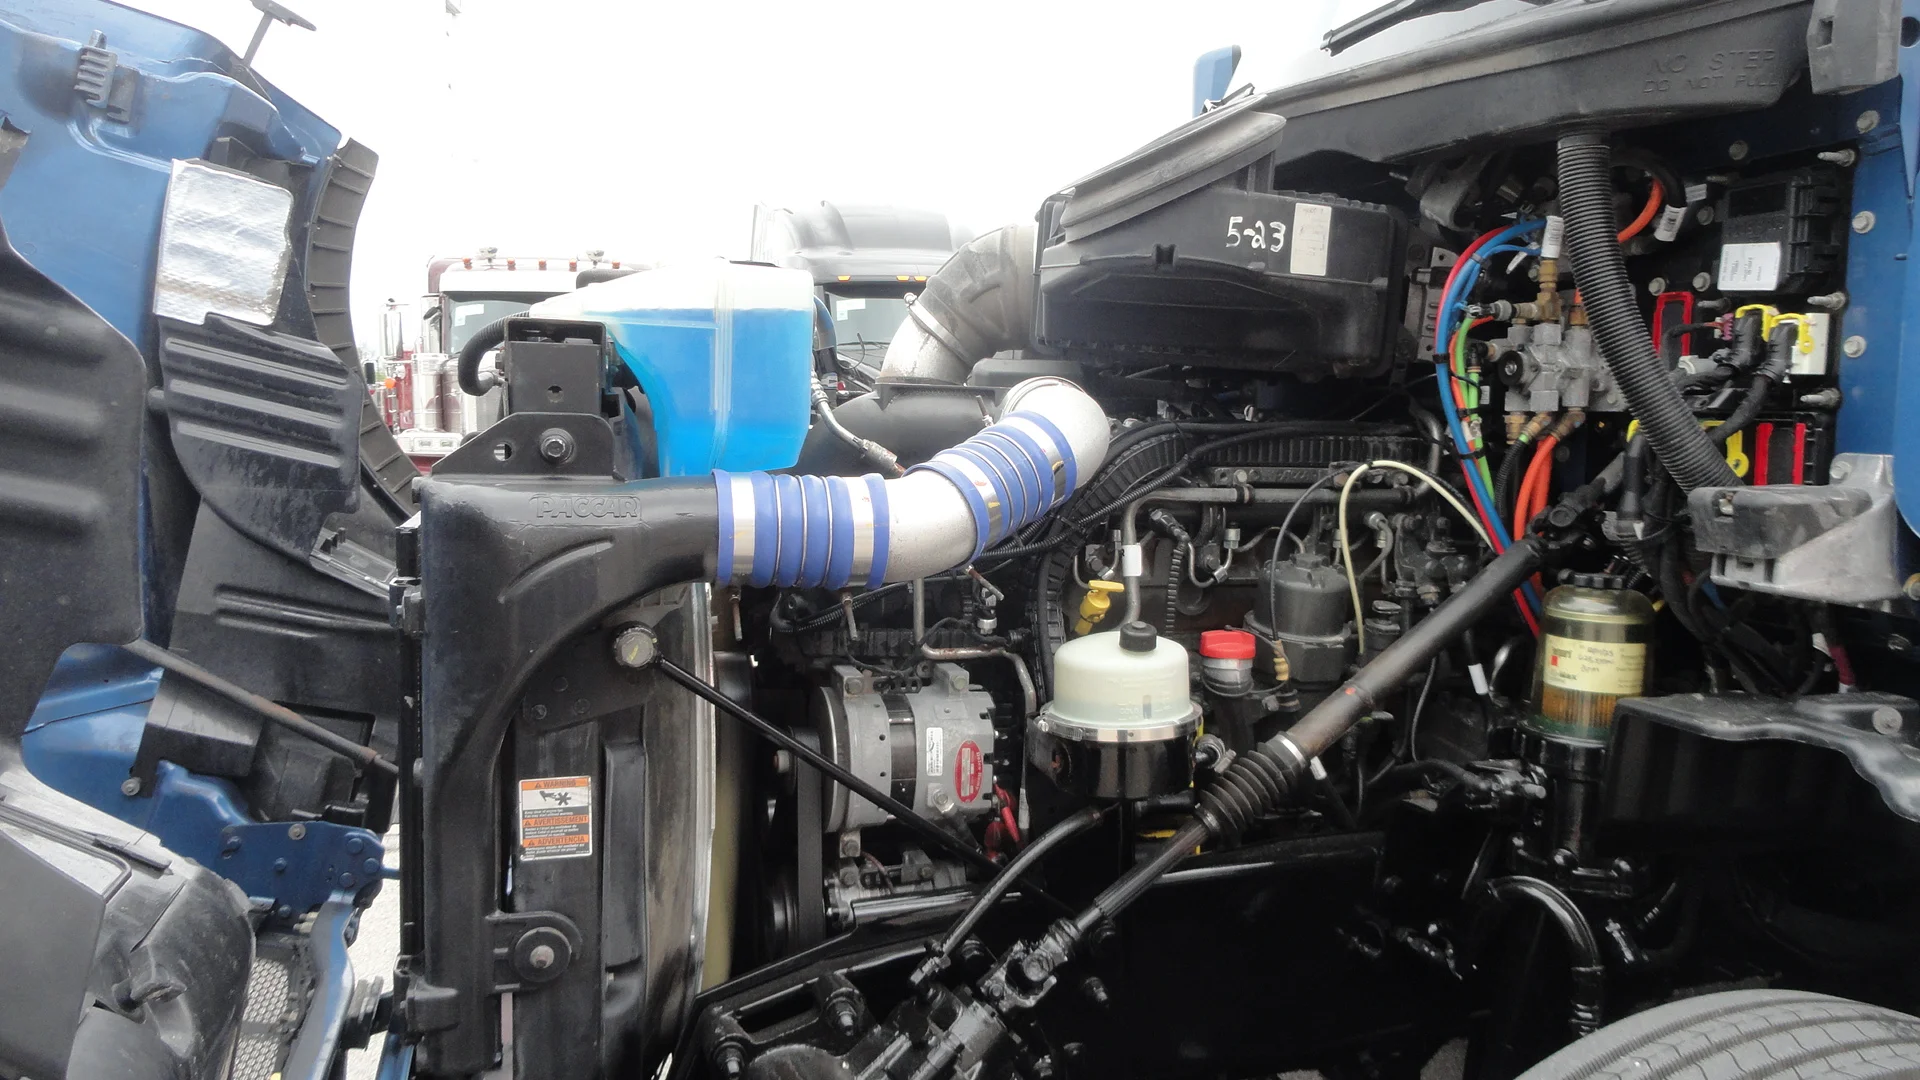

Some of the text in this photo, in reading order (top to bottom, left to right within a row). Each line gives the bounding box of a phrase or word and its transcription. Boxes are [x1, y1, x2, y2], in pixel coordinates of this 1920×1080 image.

[1648, 49, 1776, 74] NO STEP
[1642, 79, 1671, 94] DO
[1687, 75, 1724, 90] NOT
[1225, 216, 1287, 253] 5-23
[536, 496, 638, 518] PACCAR
[544, 779, 576, 787] WARNING
[534, 816, 587, 825] AVERTISSEMENT
[538, 835, 584, 845] ADVERTENCIA
